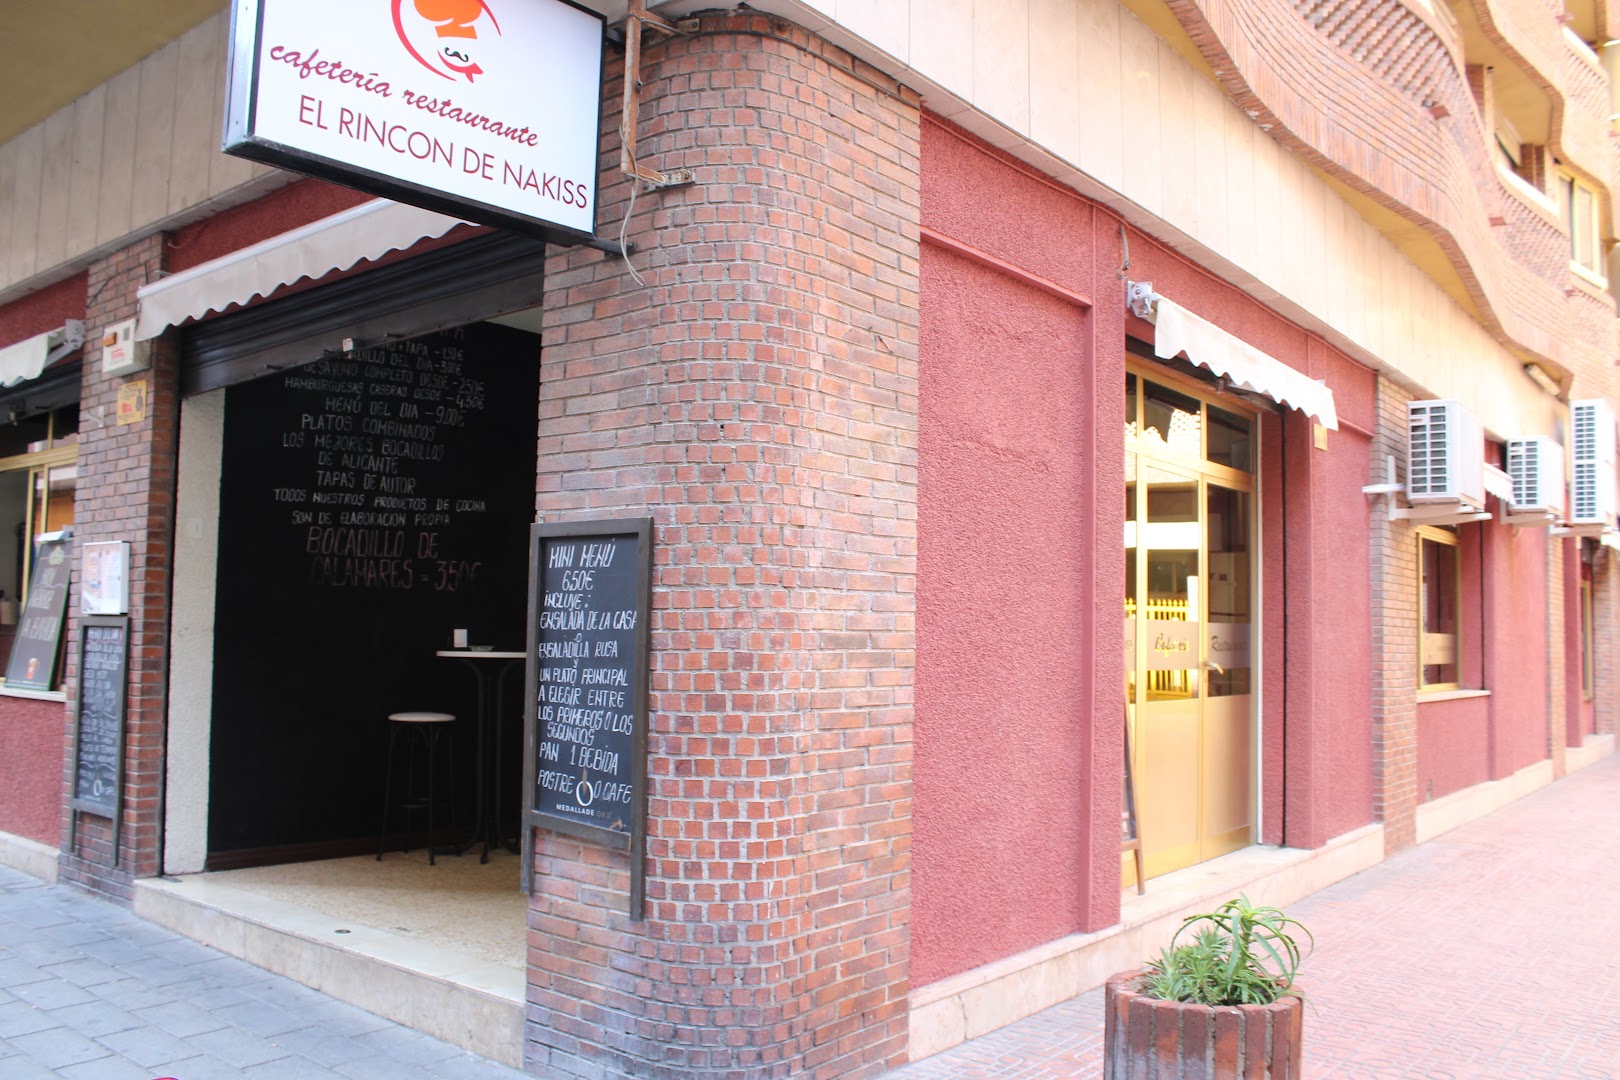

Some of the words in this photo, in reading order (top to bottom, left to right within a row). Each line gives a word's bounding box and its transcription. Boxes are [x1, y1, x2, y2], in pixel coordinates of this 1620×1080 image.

[270, 44, 392, 98] cafetería
[402, 88, 539, 147] restaurante
[299, 94, 328, 130] EL
[339, 107, 454, 168] RINCON
[463, 147, 493, 181] DE
[503, 159, 588, 209] NAKISS
[405, 341, 429, 357] TAPA
[285, 376, 363, 395] HAMBURGUESAS
[370, 382, 408, 397] CASERAS
[414, 387, 441, 401] DESDE
[364, 364, 413, 384] COMPLETO
[420, 373, 449, 391] DESDE
[370, 400, 391, 416] DEL
[400, 402, 419, 419] DIA
[302, 413, 352, 432] PLATOS
[362, 416, 435, 442] COMBINADOS
[283, 432, 304, 448] LOS
[315, 434, 373, 452] MEJORES
[381, 438, 444, 462] BOCADILLOS
[318, 451, 333, 466] DE
[341, 454, 399, 475] ALICANTE
[317, 471, 355, 489] TAPAS
[364, 474, 376, 490] DE
[380, 475, 416, 495] AUTOR
[274, 488, 307, 502] TODOS
[313, 492, 365, 506] NUESTROS
[374, 496, 427, 511] PRODUCTOS
[436, 499, 449, 511] DE
[456, 498, 487, 512] COCINA
[292, 510, 312, 525] SON
[318, 512, 332, 525] DE
[340, 511, 406, 527] ELABORACION
[415, 513, 450, 527] PROPIA
[306, 526, 405, 558] BOCADILLO
[418, 532, 440, 559] DE
[549, 545, 575, 568] MINI
[580, 538, 616, 568] MENÚ
[311, 556, 413, 589] CALAMARES
[540, 610, 584, 630] ENSALADA
[586, 610, 598, 631] DE
[599, 612, 610, 630] LA
[539, 640, 589, 659] ENSALADILLA
[594, 640, 618, 658] RUSA
[540, 667, 550, 682] UN
[552, 667, 577, 684] PLATO
[581, 668, 629, 687] PRINCIPAL
[538, 685, 545, 702] A
[549, 685, 582, 706] ELEGIR
[587, 689, 625, 708] ENTRE
[538, 705, 553, 721] LOS
[557, 706, 603, 730] PRIMEROS
[604, 711, 612, 730] O
[612, 714, 633, 736] LOS
[547, 722, 595, 747] SEGUNDOS
[539, 742, 560, 762] PAN
[570, 745, 576, 766] 1
[578, 745, 619, 776] BEBIDA
[538, 769, 575, 795] POSTRE
